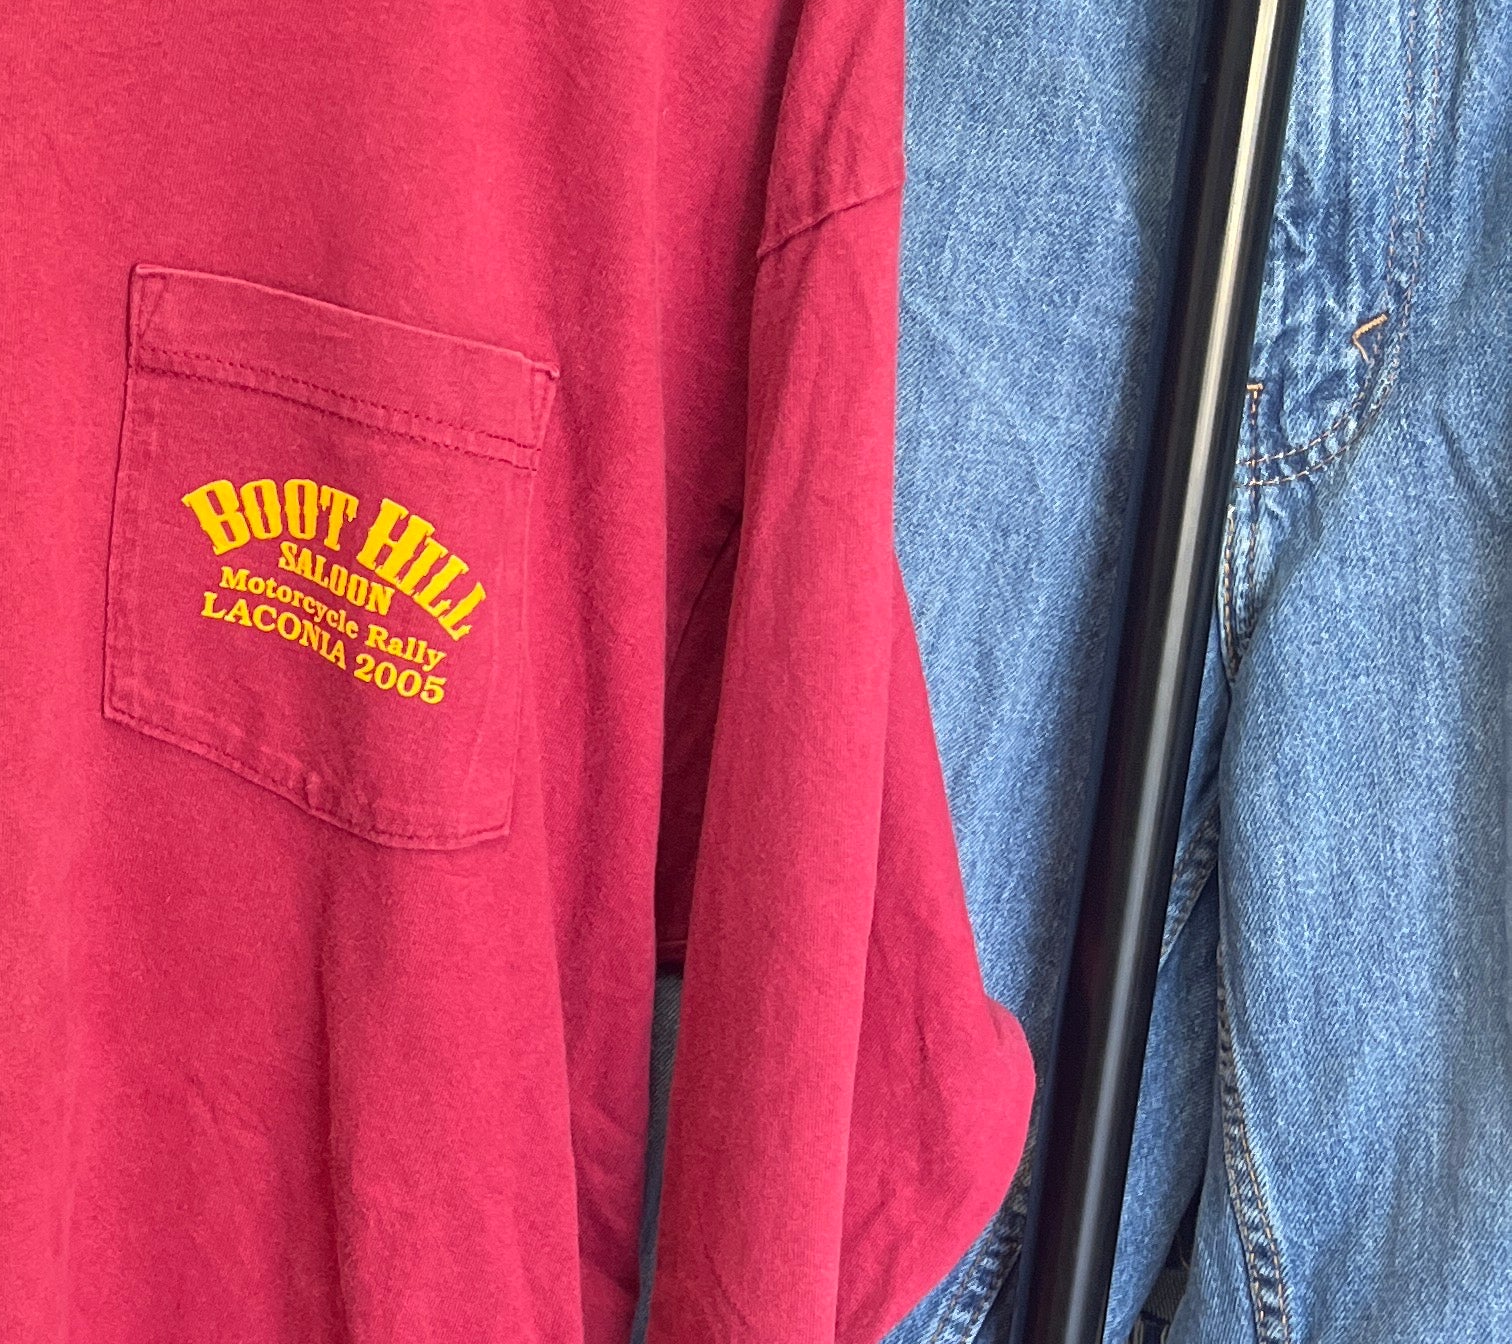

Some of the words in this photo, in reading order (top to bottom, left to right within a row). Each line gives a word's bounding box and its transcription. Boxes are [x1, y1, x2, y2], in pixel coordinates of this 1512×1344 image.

[181, 479, 360, 556] BOOT
[356, 498, 487, 642] HILL
[278, 541, 395, 616] SALOON
[200, 591, 347, 670] LACONIA
[353, 654, 447, 704] 2005
[219, 566, 360, 639] Motorcycle
[364, 624, 447, 672] Rally
